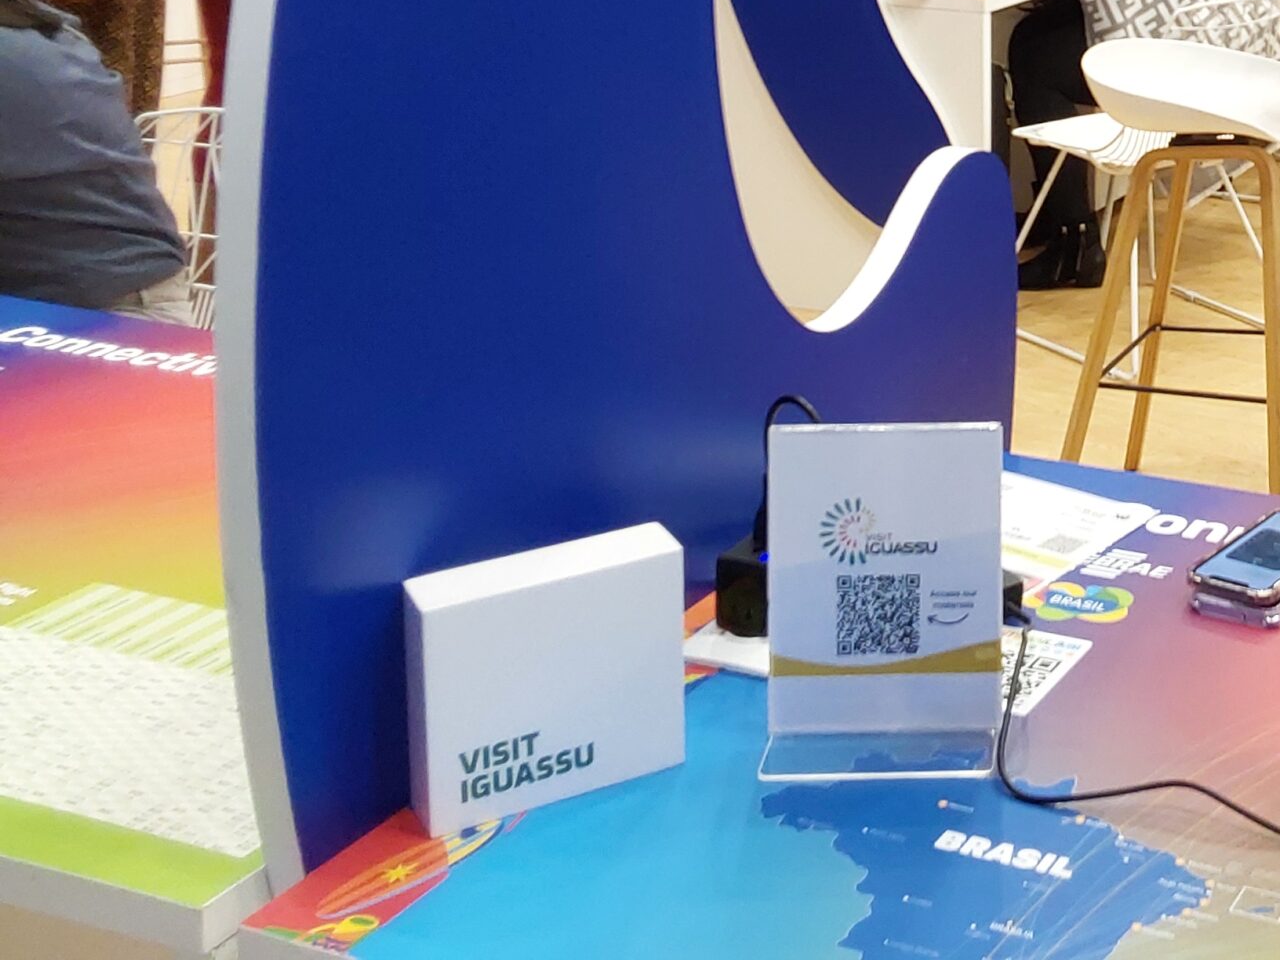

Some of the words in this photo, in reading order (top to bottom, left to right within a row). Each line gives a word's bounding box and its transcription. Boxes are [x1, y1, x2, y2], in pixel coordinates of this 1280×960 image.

[865, 540, 938, 555] IGUASSU
[1049, 593, 1106, 613] BRASIL
[458, 731, 539, 774] VISIT
[460, 742, 594, 803] IGUASSU
[934, 829, 1073, 880] BRASIL
